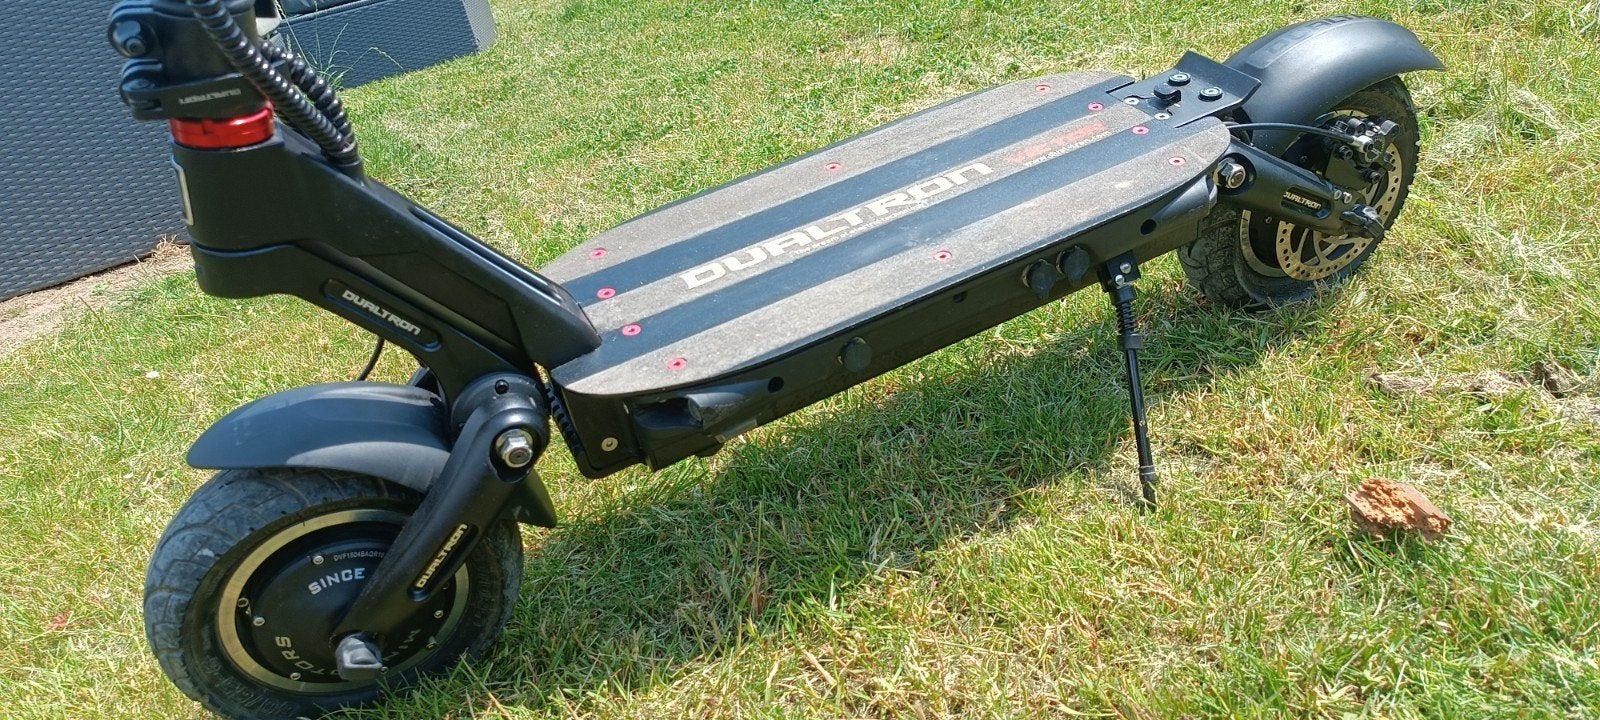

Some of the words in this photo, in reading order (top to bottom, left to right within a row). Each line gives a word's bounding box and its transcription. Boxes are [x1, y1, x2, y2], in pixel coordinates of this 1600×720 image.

[679, 162, 995, 290] DUALTRON
[342, 289, 421, 335] DUALTRON
[308, 567, 366, 595] SINCE
[416, 523, 468, 588] DUALTRON
